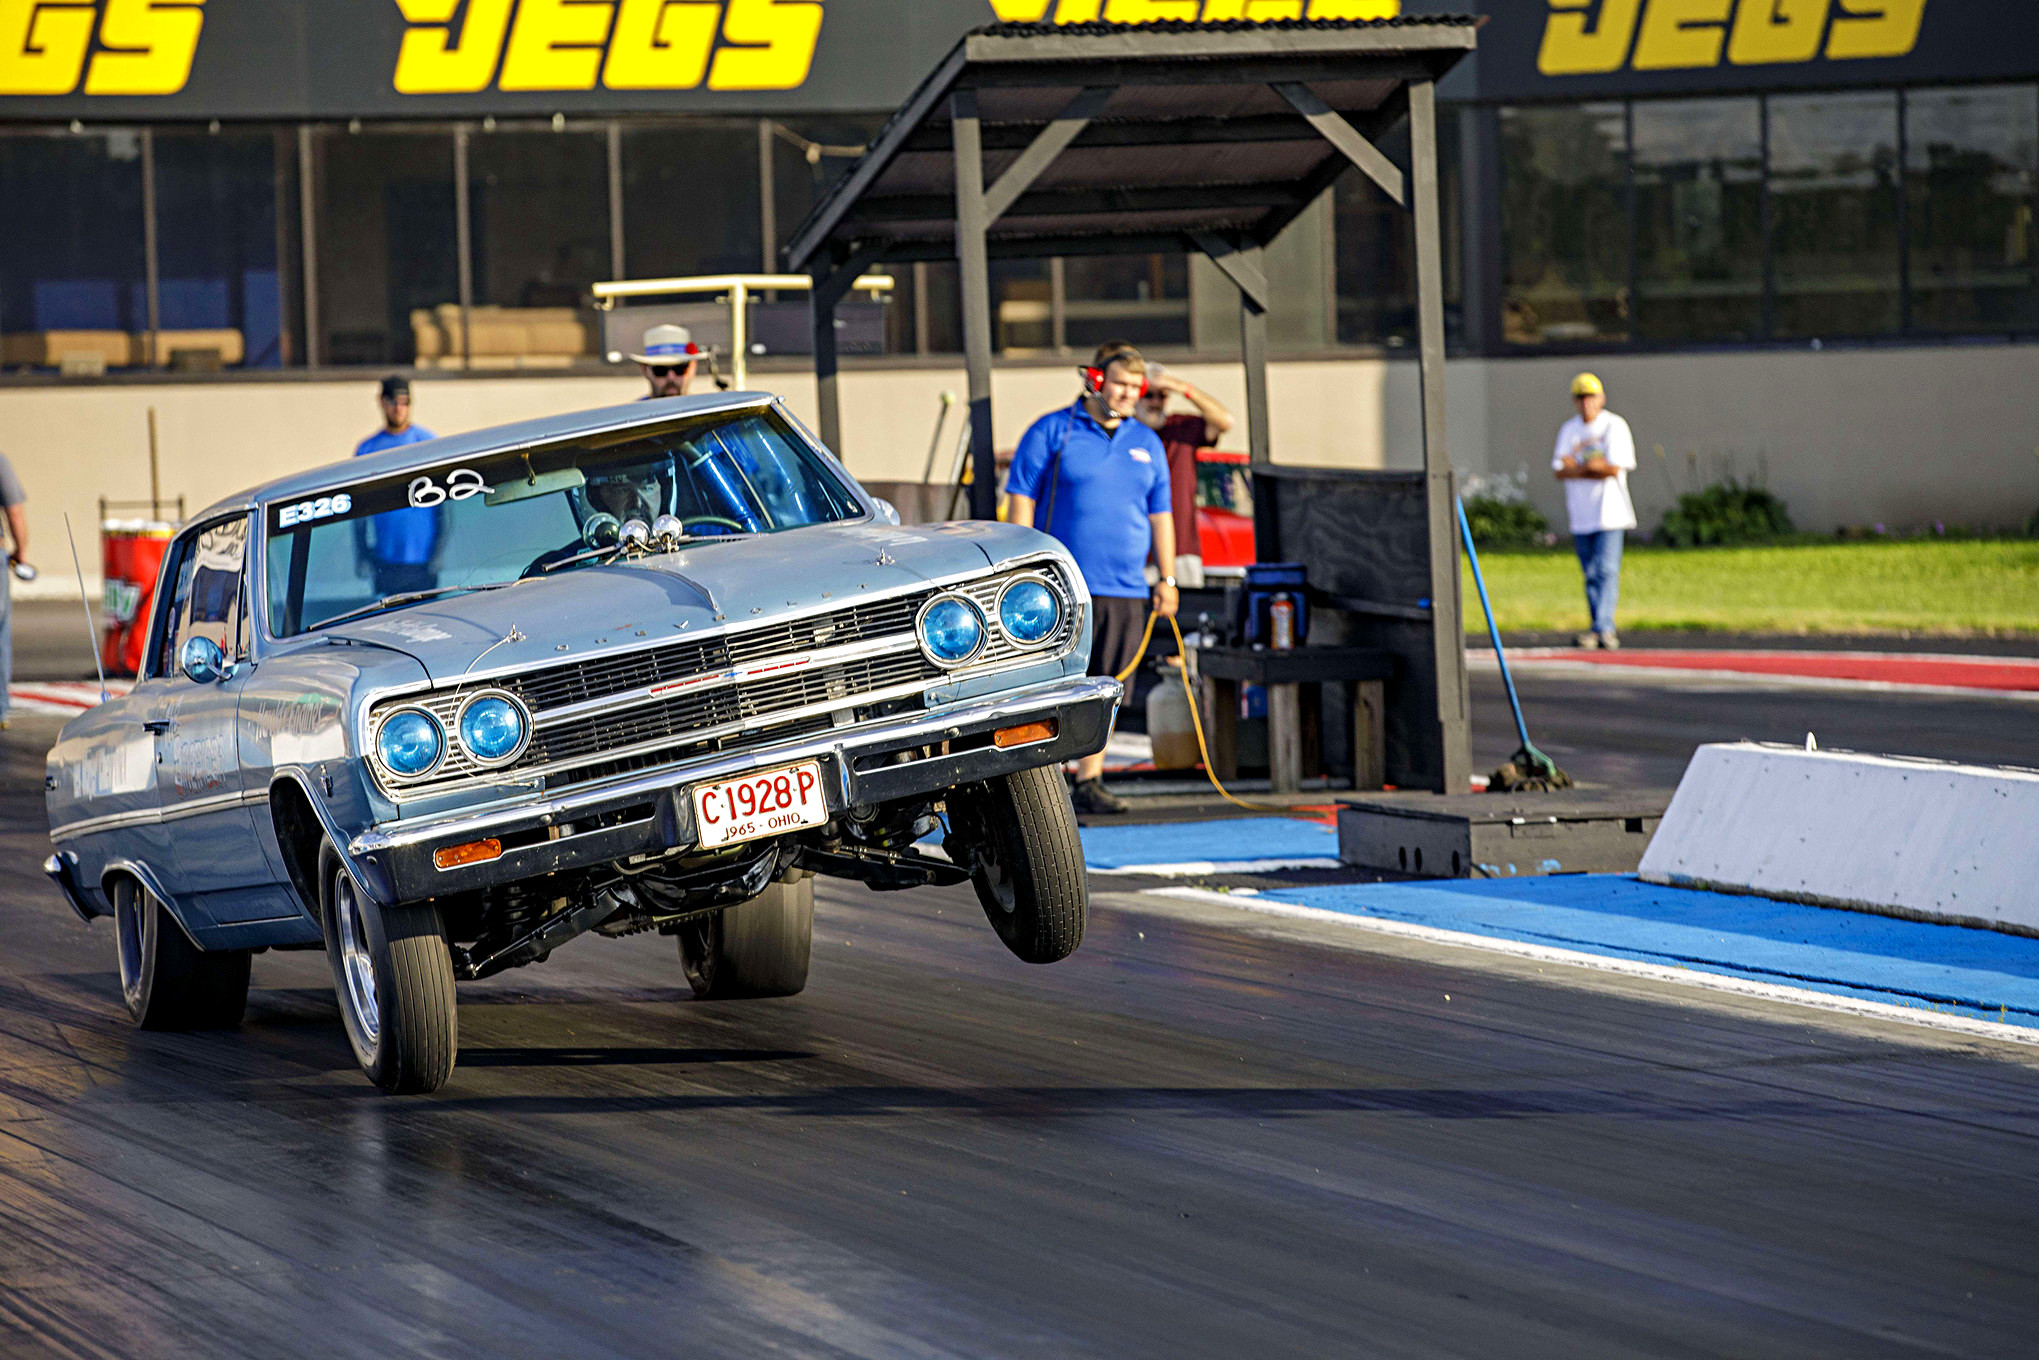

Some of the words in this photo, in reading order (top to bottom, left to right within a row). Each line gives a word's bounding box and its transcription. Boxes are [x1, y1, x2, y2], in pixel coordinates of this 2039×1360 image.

[393, 0, 826, 94] JEGS
[1537, 0, 1926, 76] JEGS
[279, 494, 351, 528] E326
[724, 822, 755, 839] 1965
[768, 812, 800, 828] OHIO
